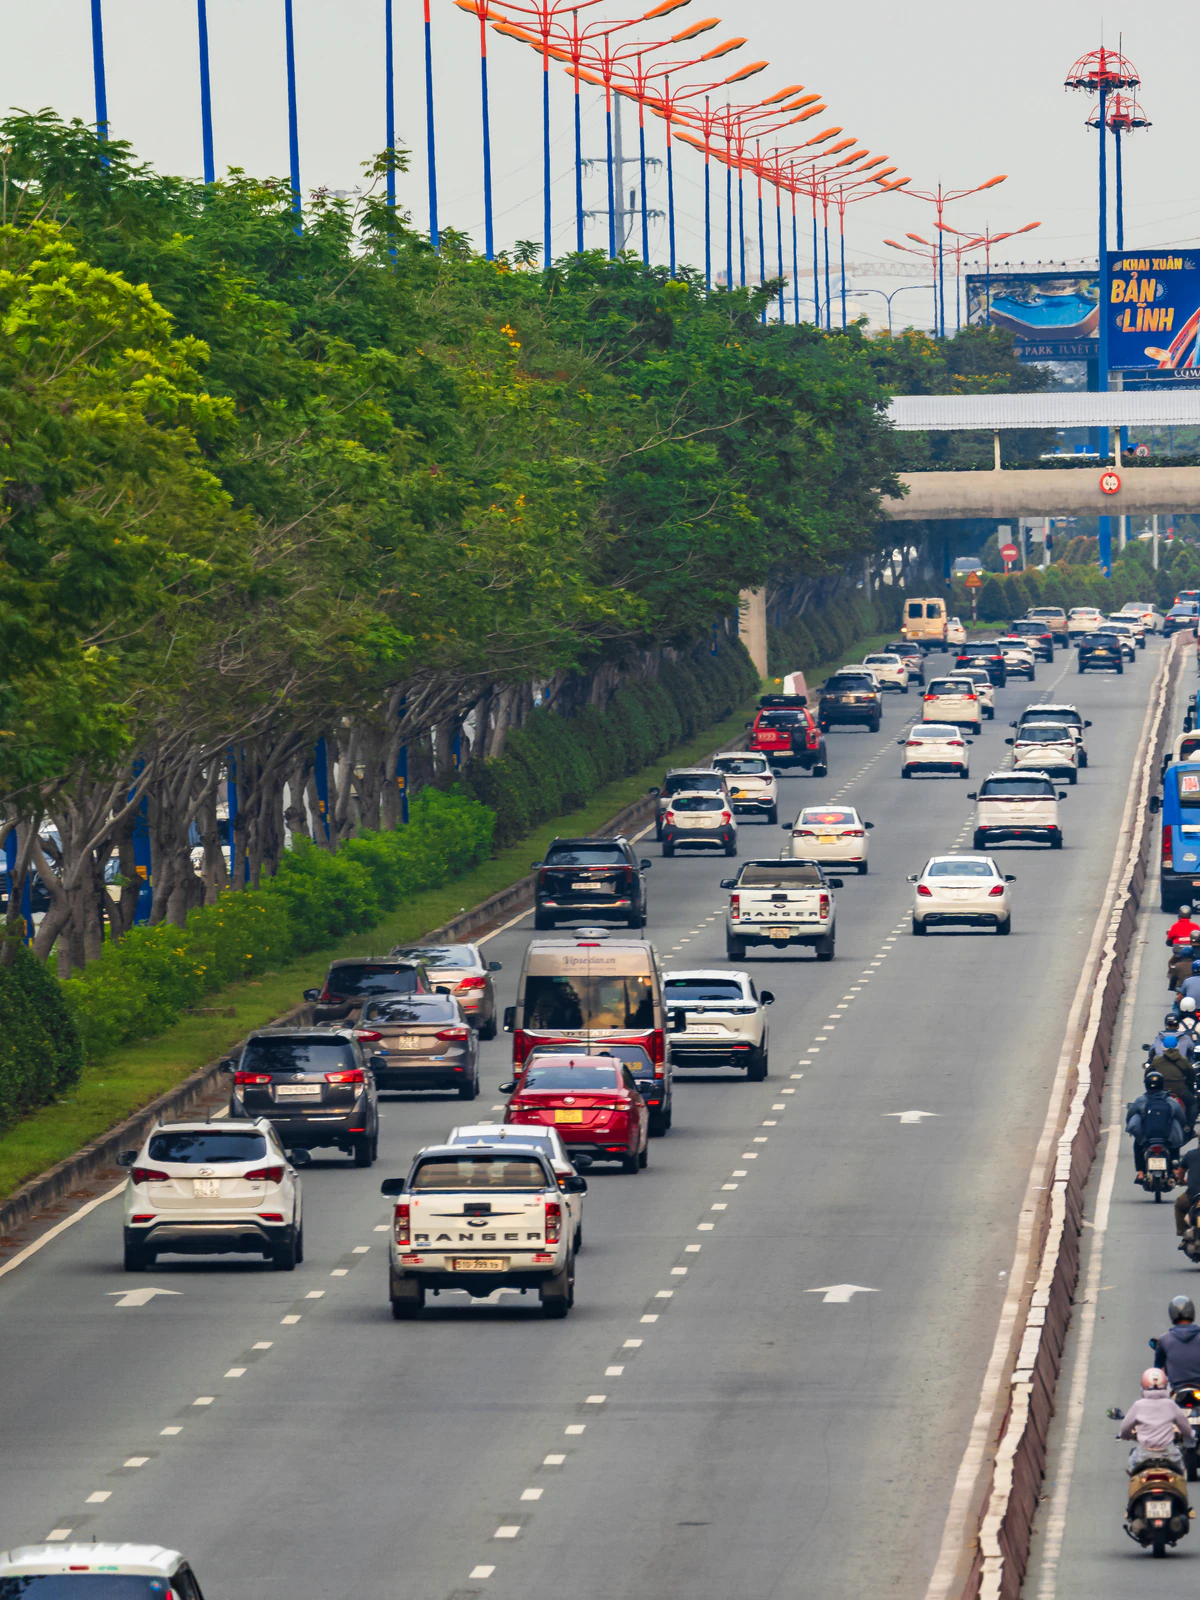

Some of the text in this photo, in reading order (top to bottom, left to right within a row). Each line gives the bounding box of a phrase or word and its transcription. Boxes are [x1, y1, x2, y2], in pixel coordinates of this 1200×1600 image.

[1122, 256, 1183, 271] KHAI XUÂN
[1111, 272, 1156, 303] BẢN
[1122, 303, 1174, 332] LĨNH
[1025, 346, 1053, 355] PARK
[1183, 777, 1199, 791] 104
[414, 1232, 542, 1242] RANGER
